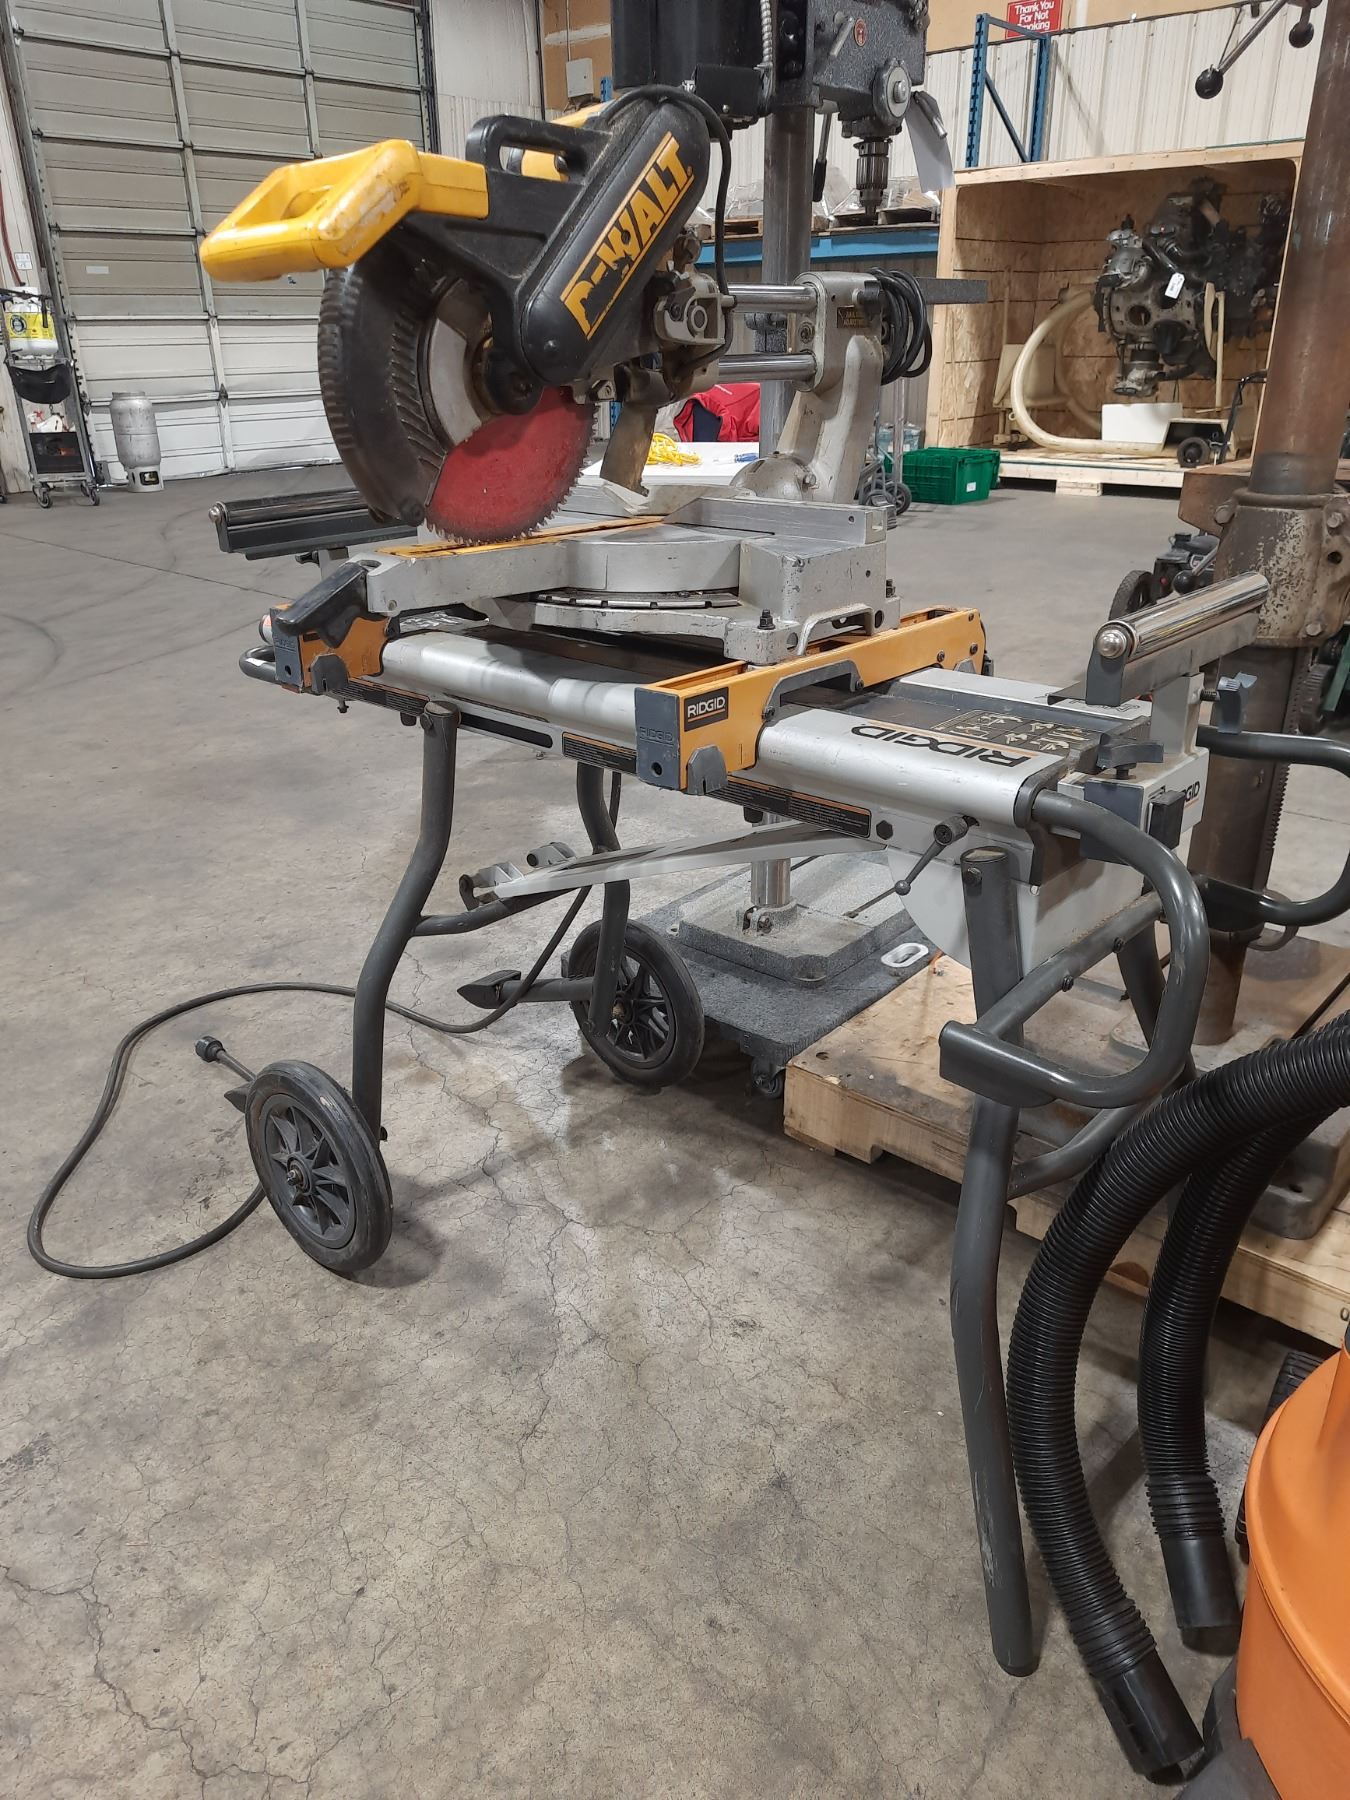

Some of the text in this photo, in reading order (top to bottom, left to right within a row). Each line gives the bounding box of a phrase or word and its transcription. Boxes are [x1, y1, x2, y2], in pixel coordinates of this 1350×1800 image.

[1015, 0, 1054, 15] Thank You
[1019, 10, 1049, 24] For Not
[564, 136, 688, 335] DWALT
[687, 696, 726, 718] RIDGID
[639, 726, 673, 742] RIDGID
[851, 725, 1032, 768] RIDGID
